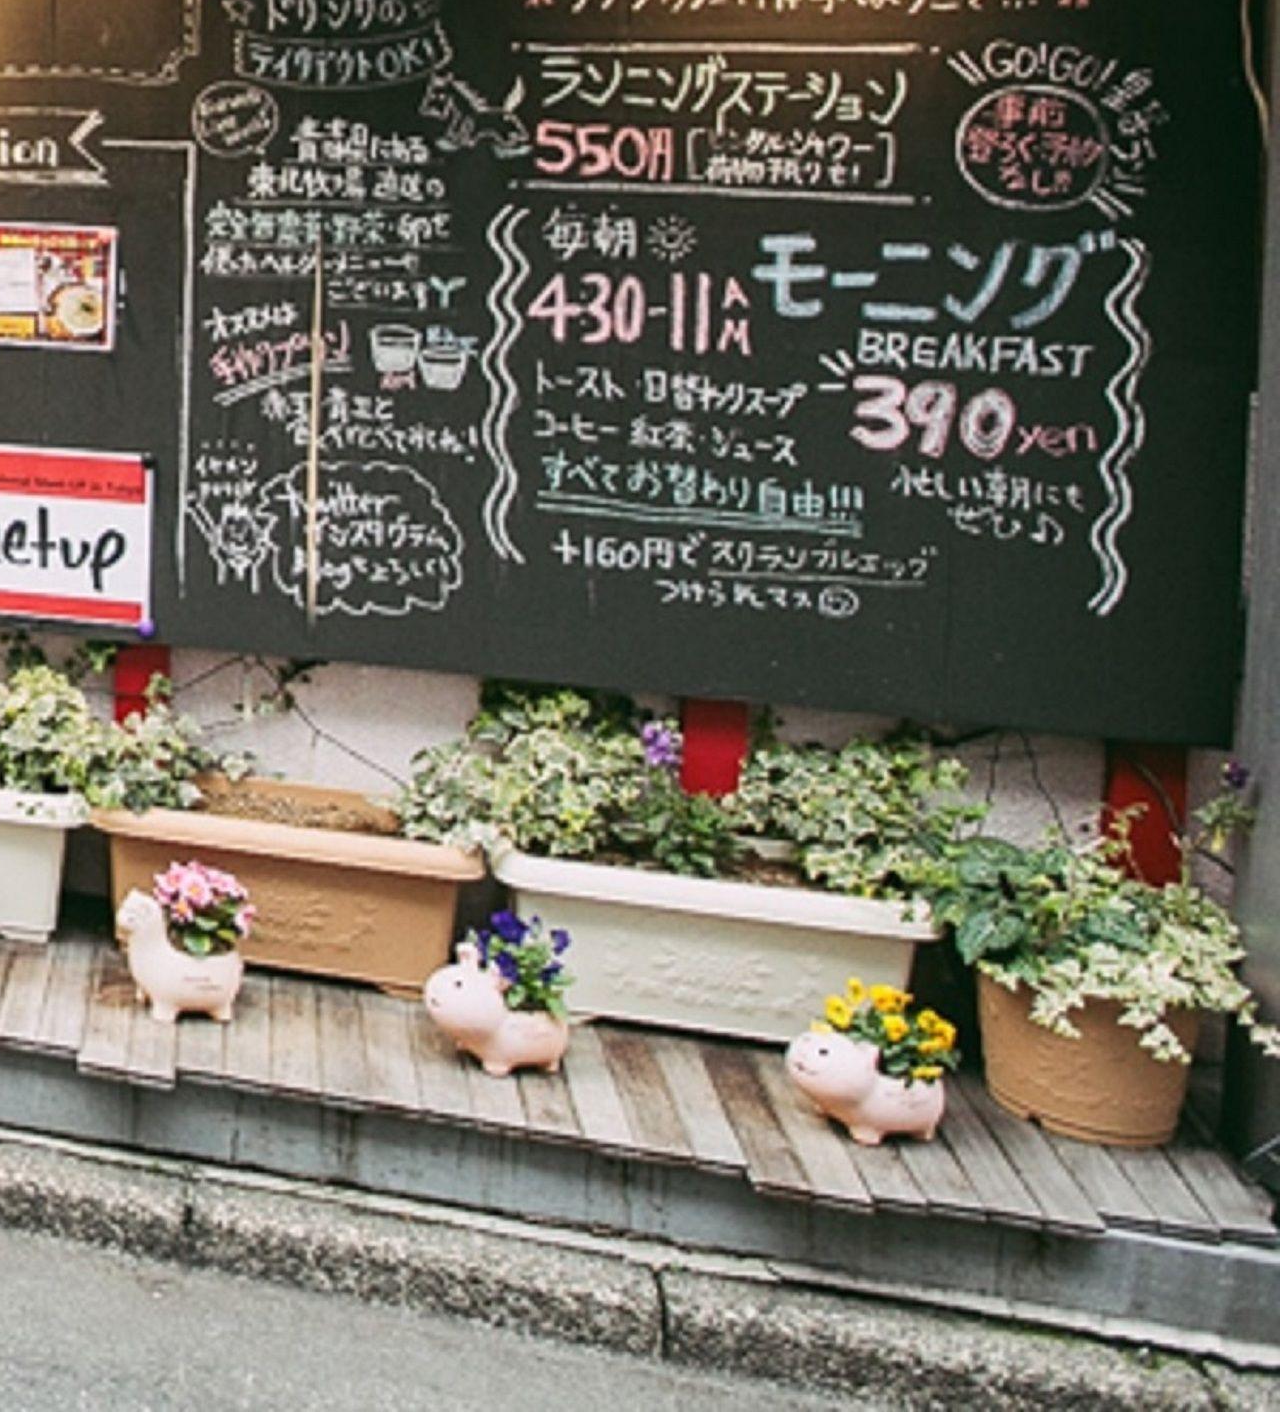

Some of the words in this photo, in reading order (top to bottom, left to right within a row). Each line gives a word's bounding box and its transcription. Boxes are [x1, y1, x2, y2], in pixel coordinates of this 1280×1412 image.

[542, 52, 909, 125] ランニングステーション
[542, 203, 639, 260] 毎朝
[750, 230, 1118, 330] モーニング
[856, 327, 1096, 378] BREAKFAST
[848, 374, 1018, 461] 390
[1016, 424, 1100, 457] yen
